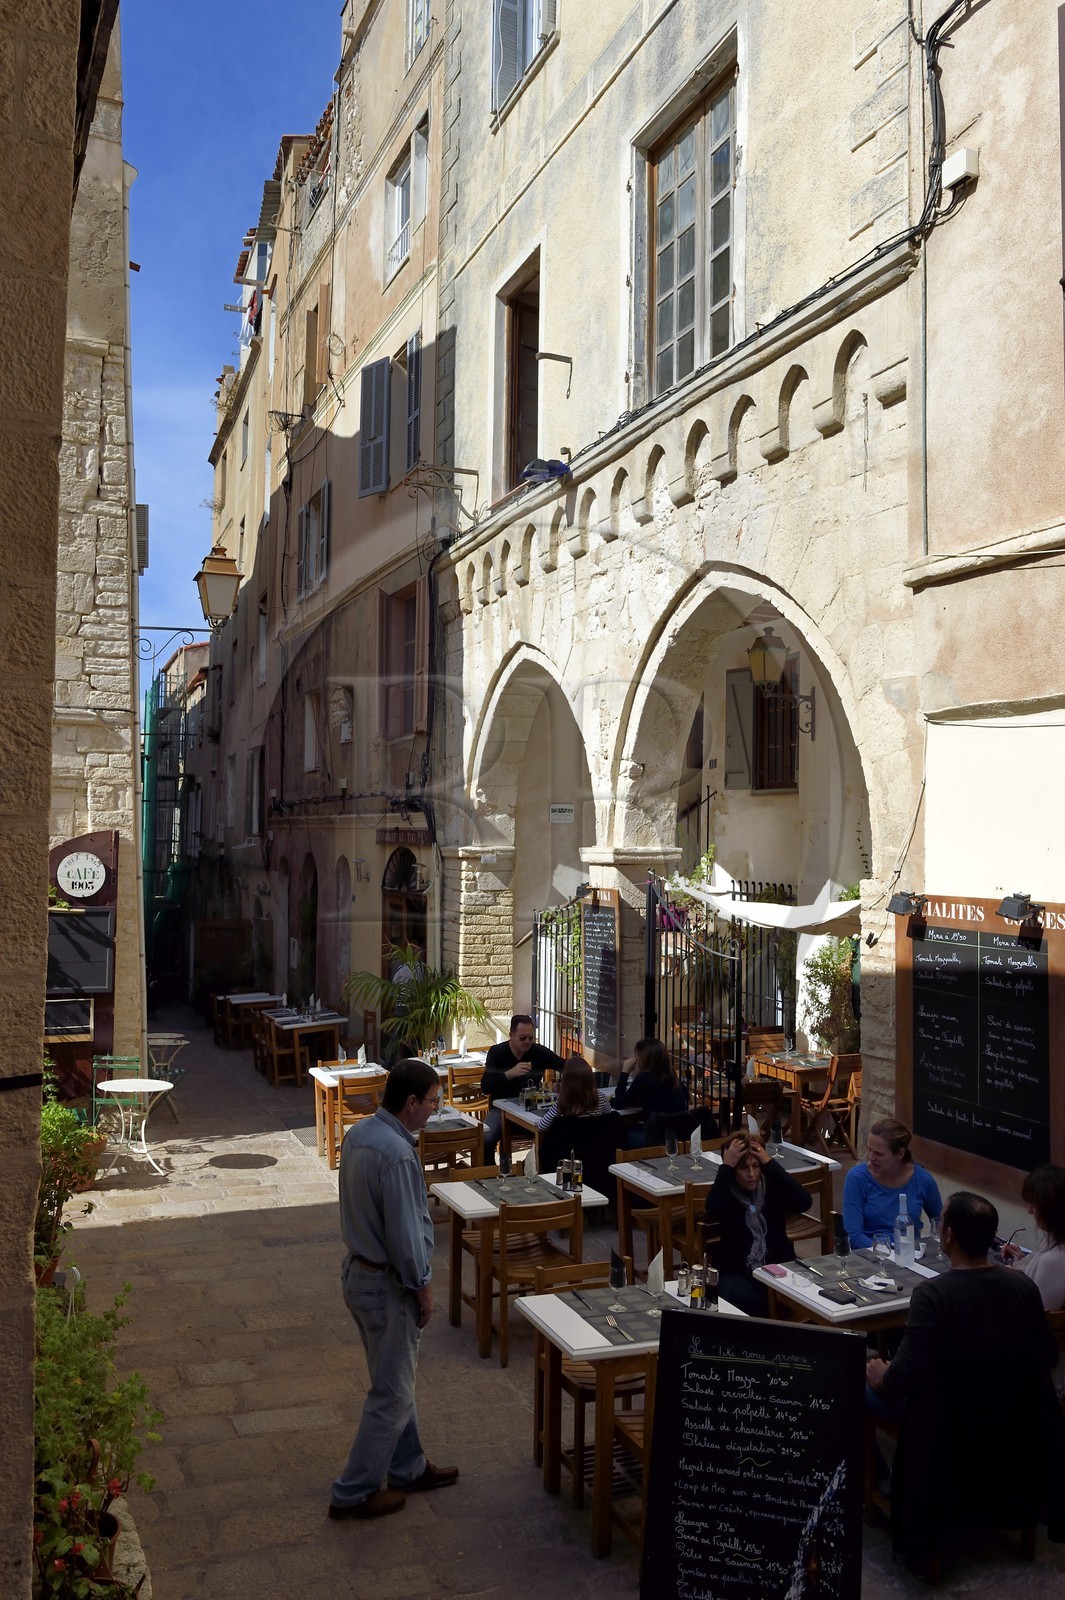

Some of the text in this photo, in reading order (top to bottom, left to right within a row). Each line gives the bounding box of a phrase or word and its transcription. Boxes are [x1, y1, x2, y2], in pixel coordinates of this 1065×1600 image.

[71, 880, 94, 890] 1905
[993, 936, 1009, 946] Menu
[982, 955, 1003, 966] Tomate
[985, 976, 1005, 988] Salade
[680, 1361, 721, 1382] Tomate
[727, 1369, 761, 1389] Mozza
[682, 1382, 715, 1396] Salade
[681, 1399, 713, 1413] Salade
[717, 1402, 731, 1414] de
[732, 1403, 771, 1422] polpetti
[684, 1417, 716, 1431] Assiette
[719, 1421, 731, 1432] de
[734, 1421, 785, 1439] charcuterie
[682, 1432, 721, 1449] Plateau
[725, 1440, 777, 1459] dégustation
[678, 1456, 706, 1477] Magret
[706, 1462, 716, 1473] de
[716, 1463, 741, 1476] canard
[678, 1480, 699, 1494] Loup
[700, 1483, 709, 1492] de
[678, 1495, 705, 1508] Saumon
[674, 1510, 709, 1533] Lasagne
[675, 1525, 700, 1542] Penne
[700, 1537, 711, 1546] au
[712, 1534, 742, 1554] Figatelli
[675, 1541, 703, 1560] Pâtes
[708, 1555, 721, 1563] au
